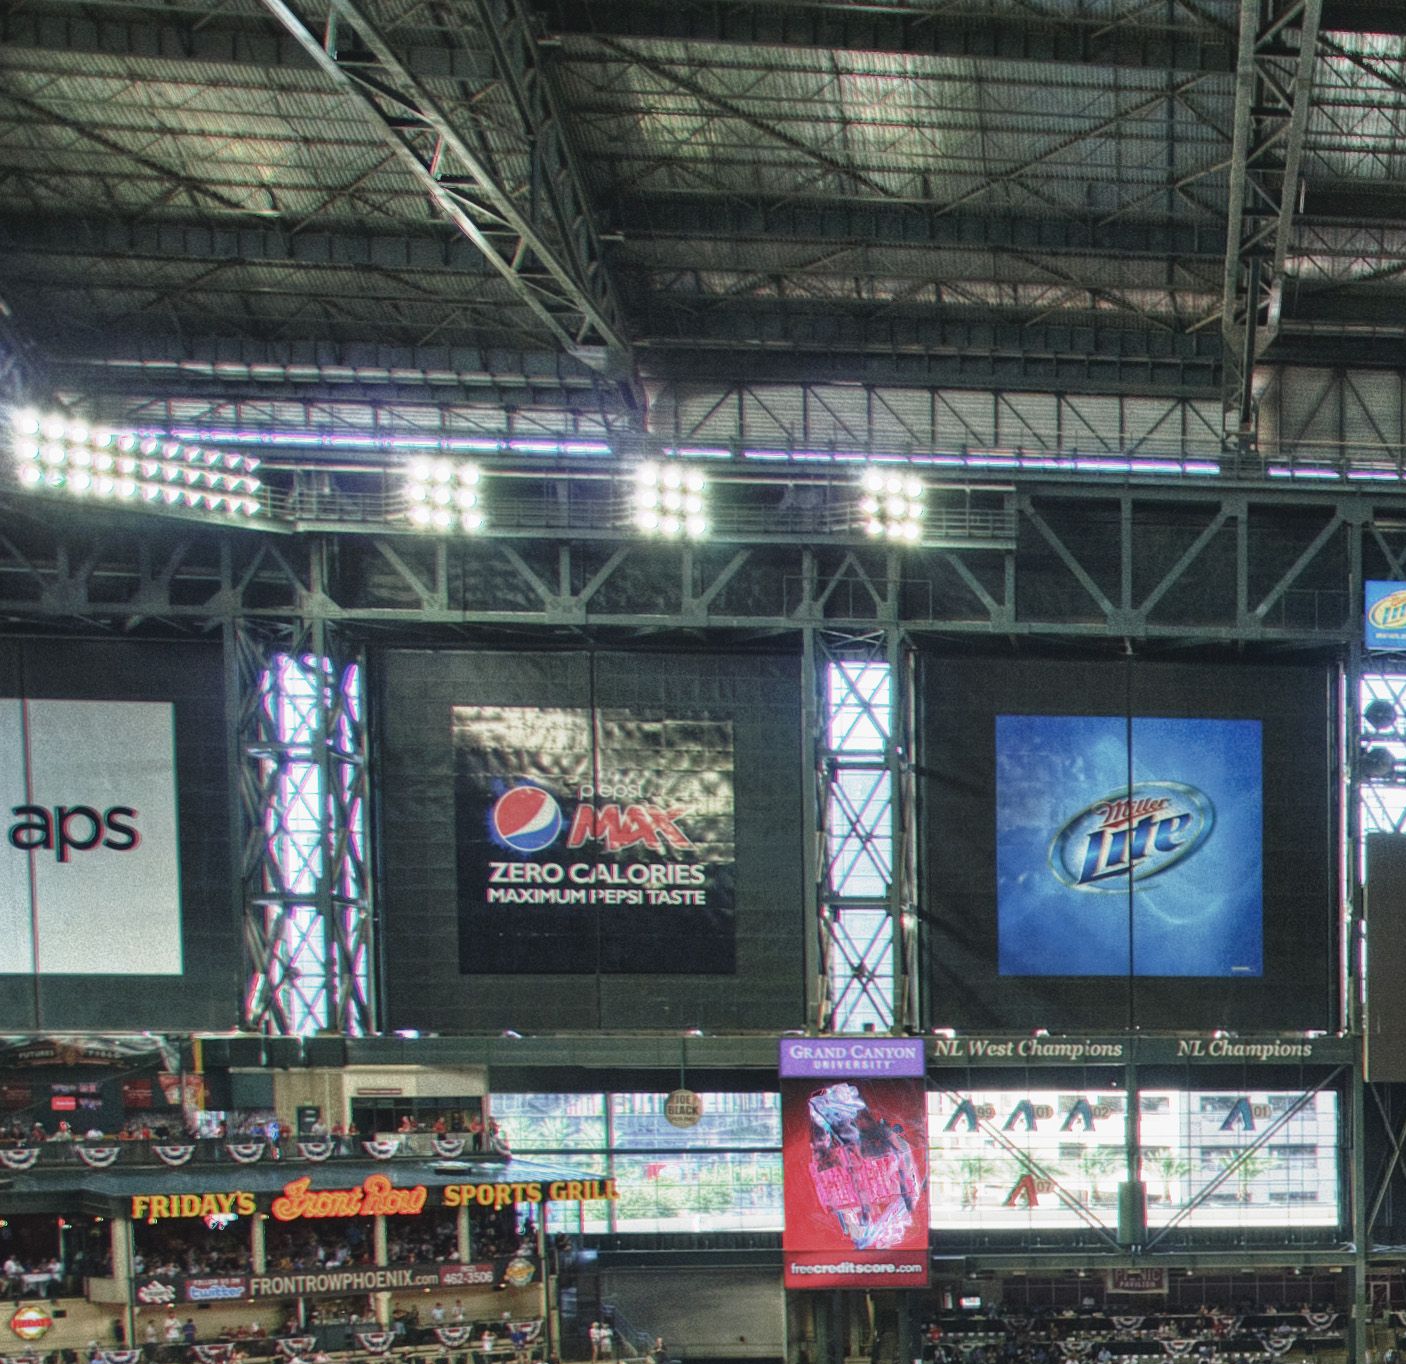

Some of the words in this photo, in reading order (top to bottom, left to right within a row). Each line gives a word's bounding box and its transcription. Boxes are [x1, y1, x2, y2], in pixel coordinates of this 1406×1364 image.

[579, 783, 644, 801] pepsi
[8, 803, 140, 863] aps
[566, 803, 700, 852] MAX
[1076, 813, 1194, 885] Lite
[488, 862, 565, 884] ZERO
[569, 862, 706, 885] CALORIES
[486, 888, 587, 904] MAXIMUM
[591, 888, 643, 904] PEPSI
[645, 889, 707, 906] TASTE
[789, 1045, 848, 1060] GRAND
[851, 1045, 917, 1060] CANYON
[934, 1040, 963, 1057] NL
[968, 1039, 1014, 1057] West
[1018, 1039, 1123, 1061] Champions
[1177, 1041, 1206, 1057] NL
[1208, 1040, 1313, 1061] Champions
[813, 1060, 891, 1070] UNIVERSITY
[131, 1191, 256, 1220] FRIDAY'S
[272, 1175, 361, 1222] Front
[360, 1173, 428, 1217] Row
[443, 1182, 541, 1207] SPORTS
[549, 1177, 621, 1203] GRILL
[790, 1263, 923, 1275] freecreditscore.com
[188, 1285, 245, 1298] twitter
[249, 1268, 440, 1297] FRONTROWPHOENIX.com
[442, 1270, 494, 1286] 462-3506
